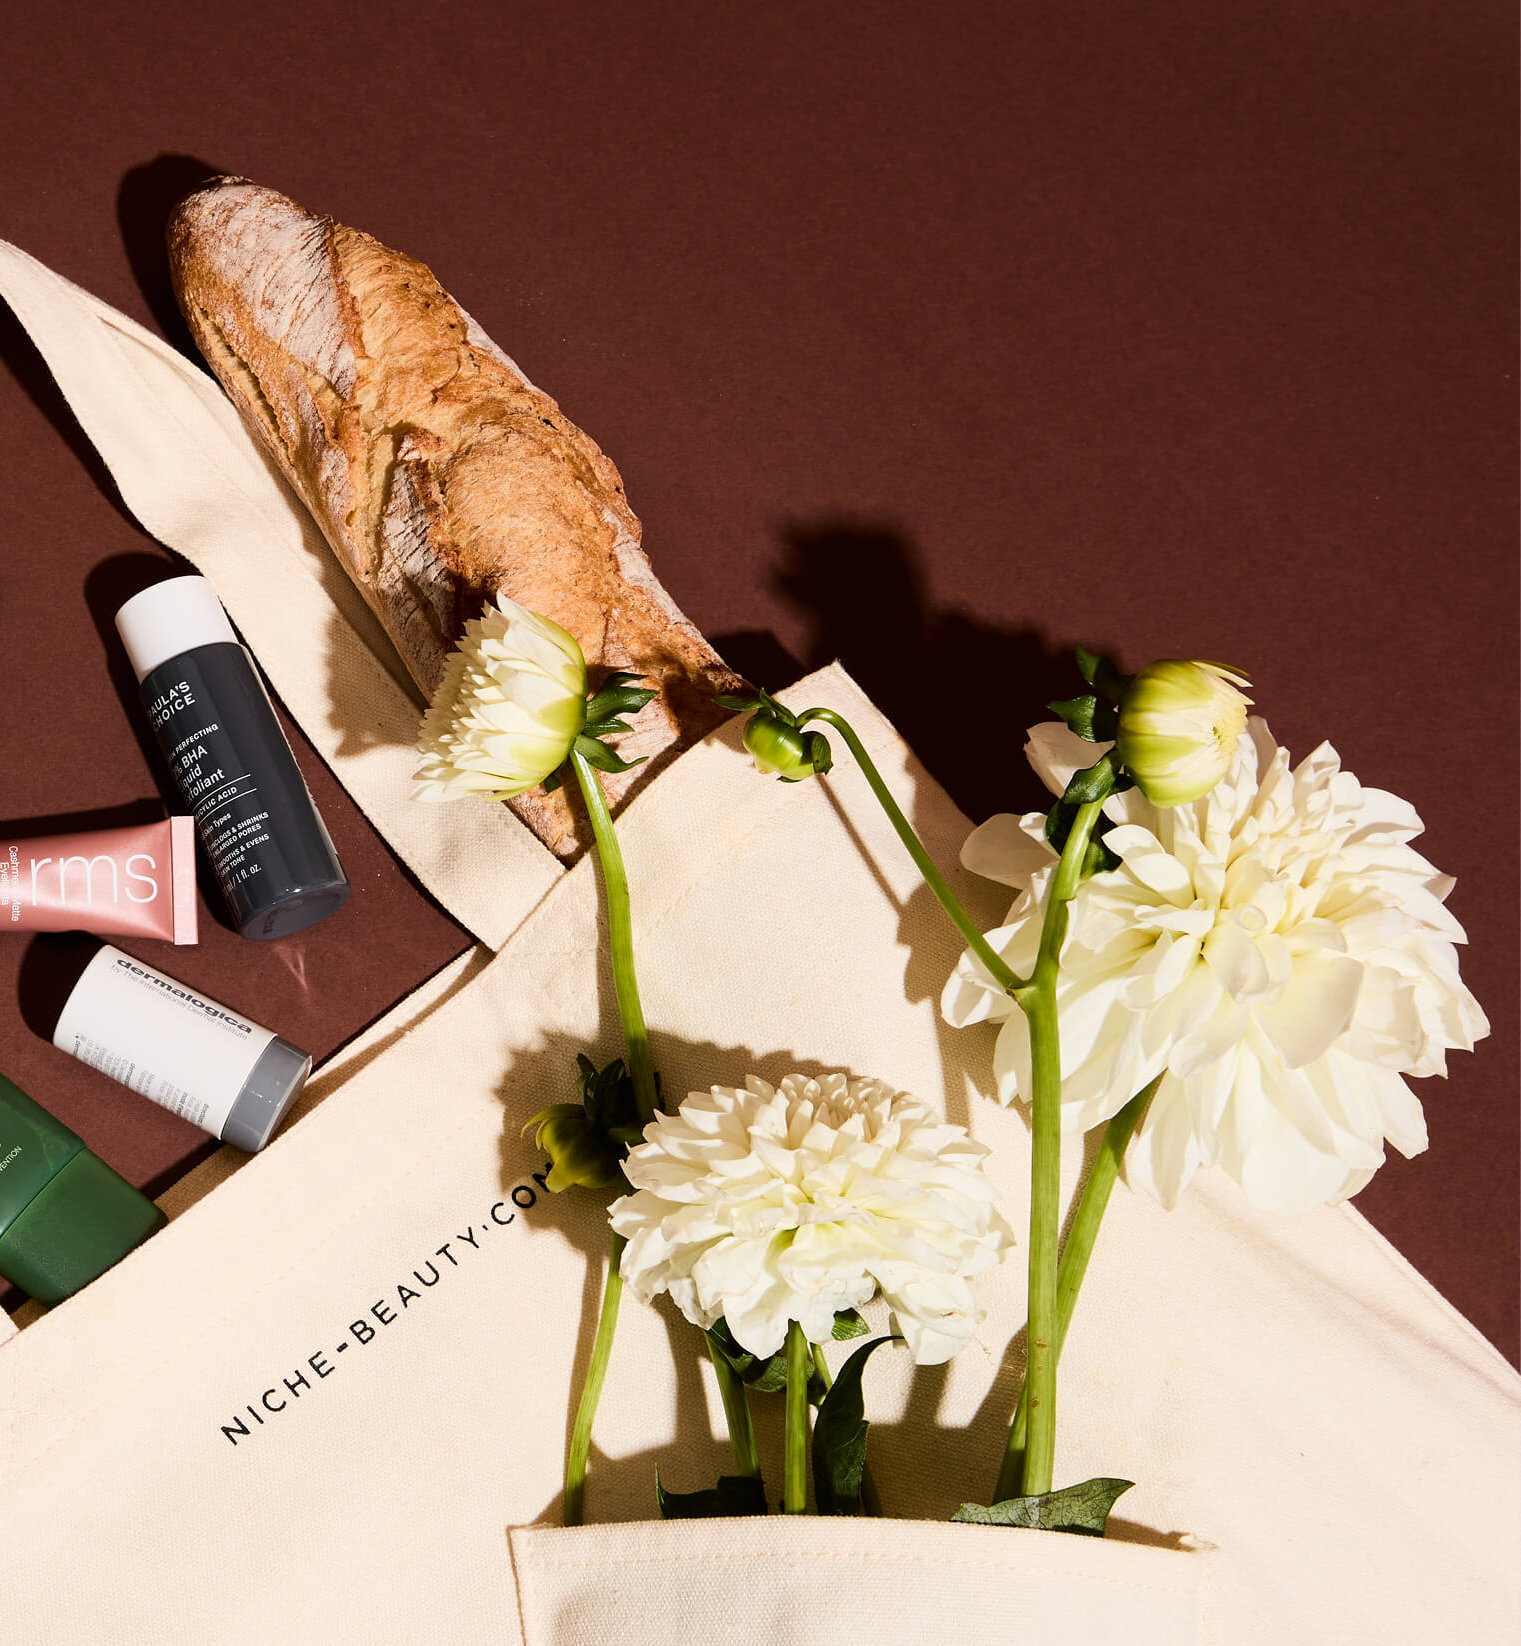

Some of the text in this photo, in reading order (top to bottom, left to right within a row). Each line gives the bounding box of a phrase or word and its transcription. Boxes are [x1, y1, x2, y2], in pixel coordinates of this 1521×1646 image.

[175, 723, 219, 756] PERFECTING
[181, 744, 208, 769] BHA
[181, 764, 203, 792] iquid
[186, 768, 226, 806] xfoliant
[217, 786, 238, 802] ACID
[213, 812, 232, 828] Types
[237, 811, 270, 830] SHRINKS
[238, 823, 262, 840] PORES
[245, 833, 270, 849] EVENS
[8, 845, 20, 892] Cashmer
[230, 854, 246, 869] TONE
[30, 854, 158, 906] rms
[116, 958, 253, 1035] dermalogica
